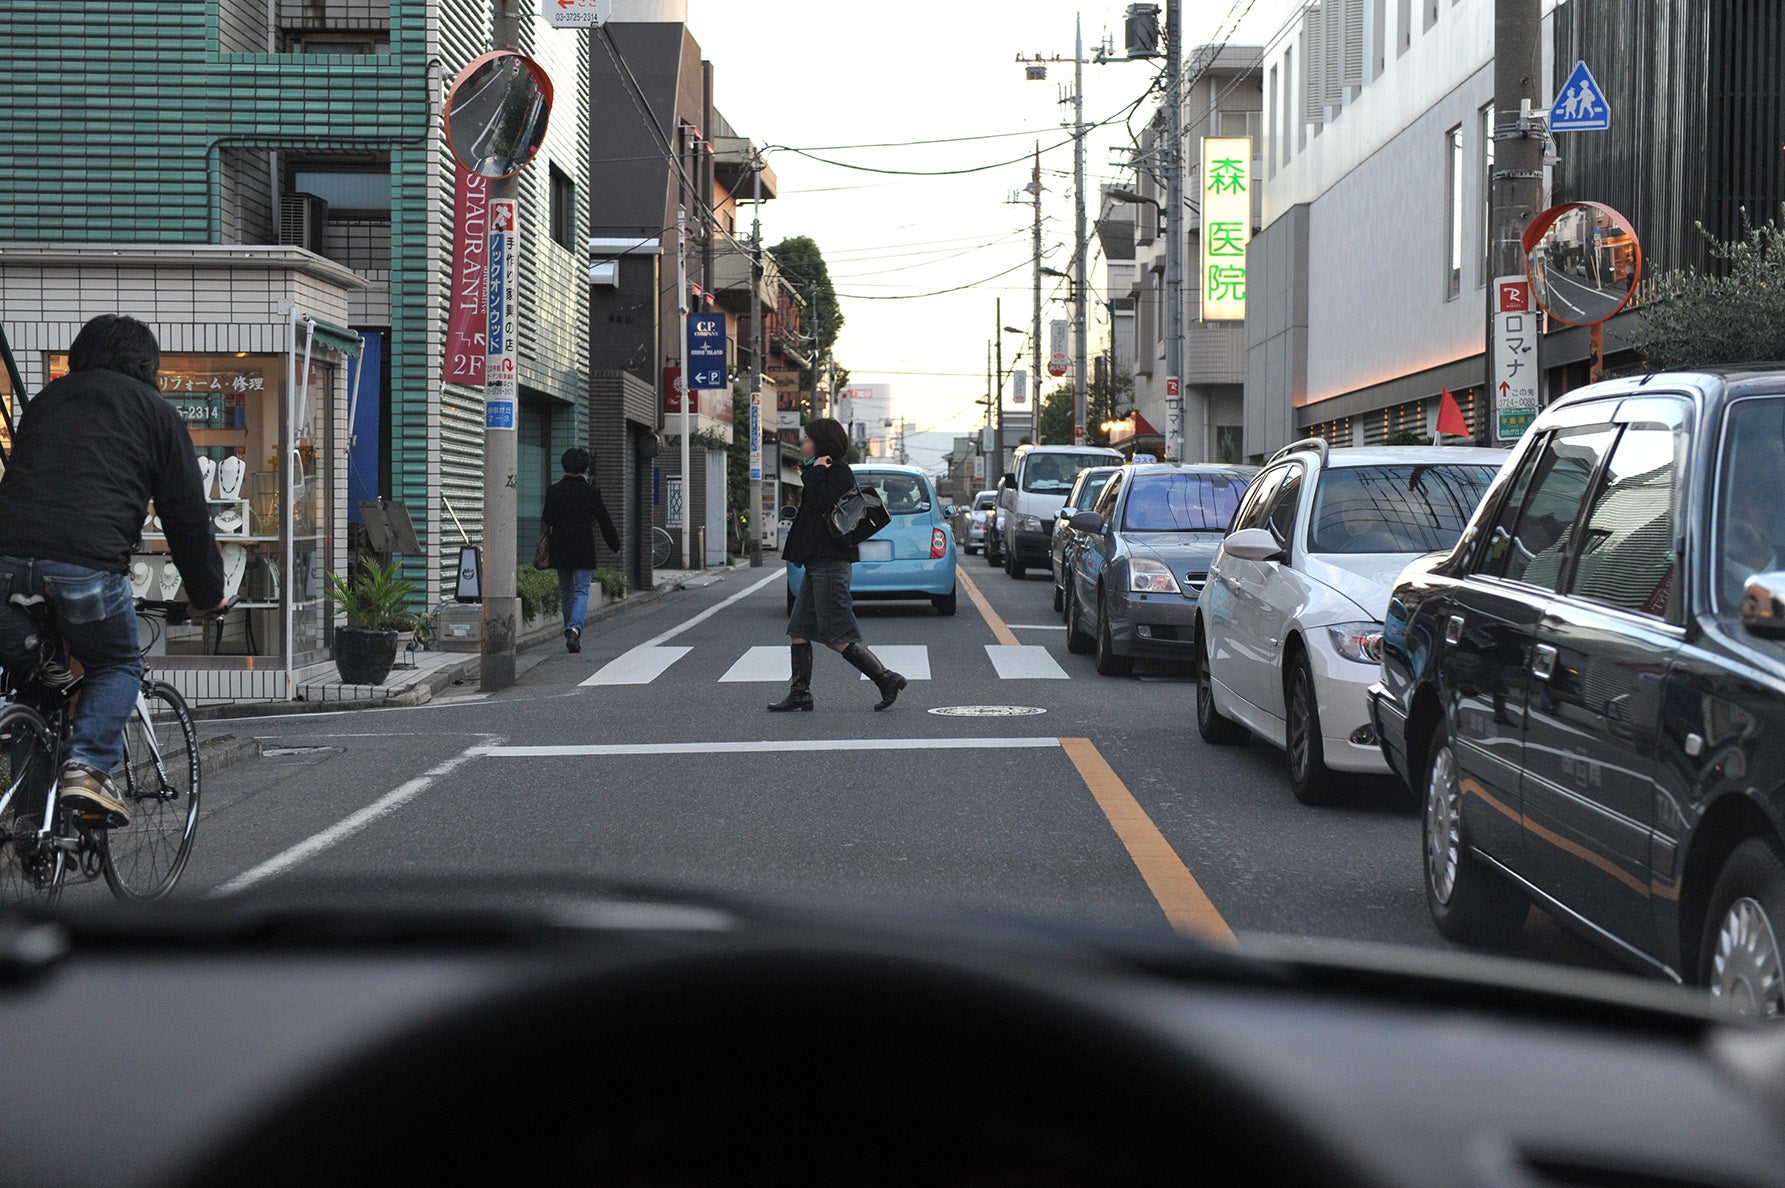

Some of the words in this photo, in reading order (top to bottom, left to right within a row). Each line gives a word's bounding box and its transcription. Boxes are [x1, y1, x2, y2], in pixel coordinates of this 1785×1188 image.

[555, 12, 598, 22] 03-3725-2314
[489, 237, 502, 352] ノックオンウッド
[505, 237, 515, 352] 手作り家具の店
[453, 354, 485, 376] 2F
[1505, 315, 1525, 378] ロマナ
[1168, 400, 1179, 439] ロマナ
[1498, 398, 1535, 407] 3724-0080
